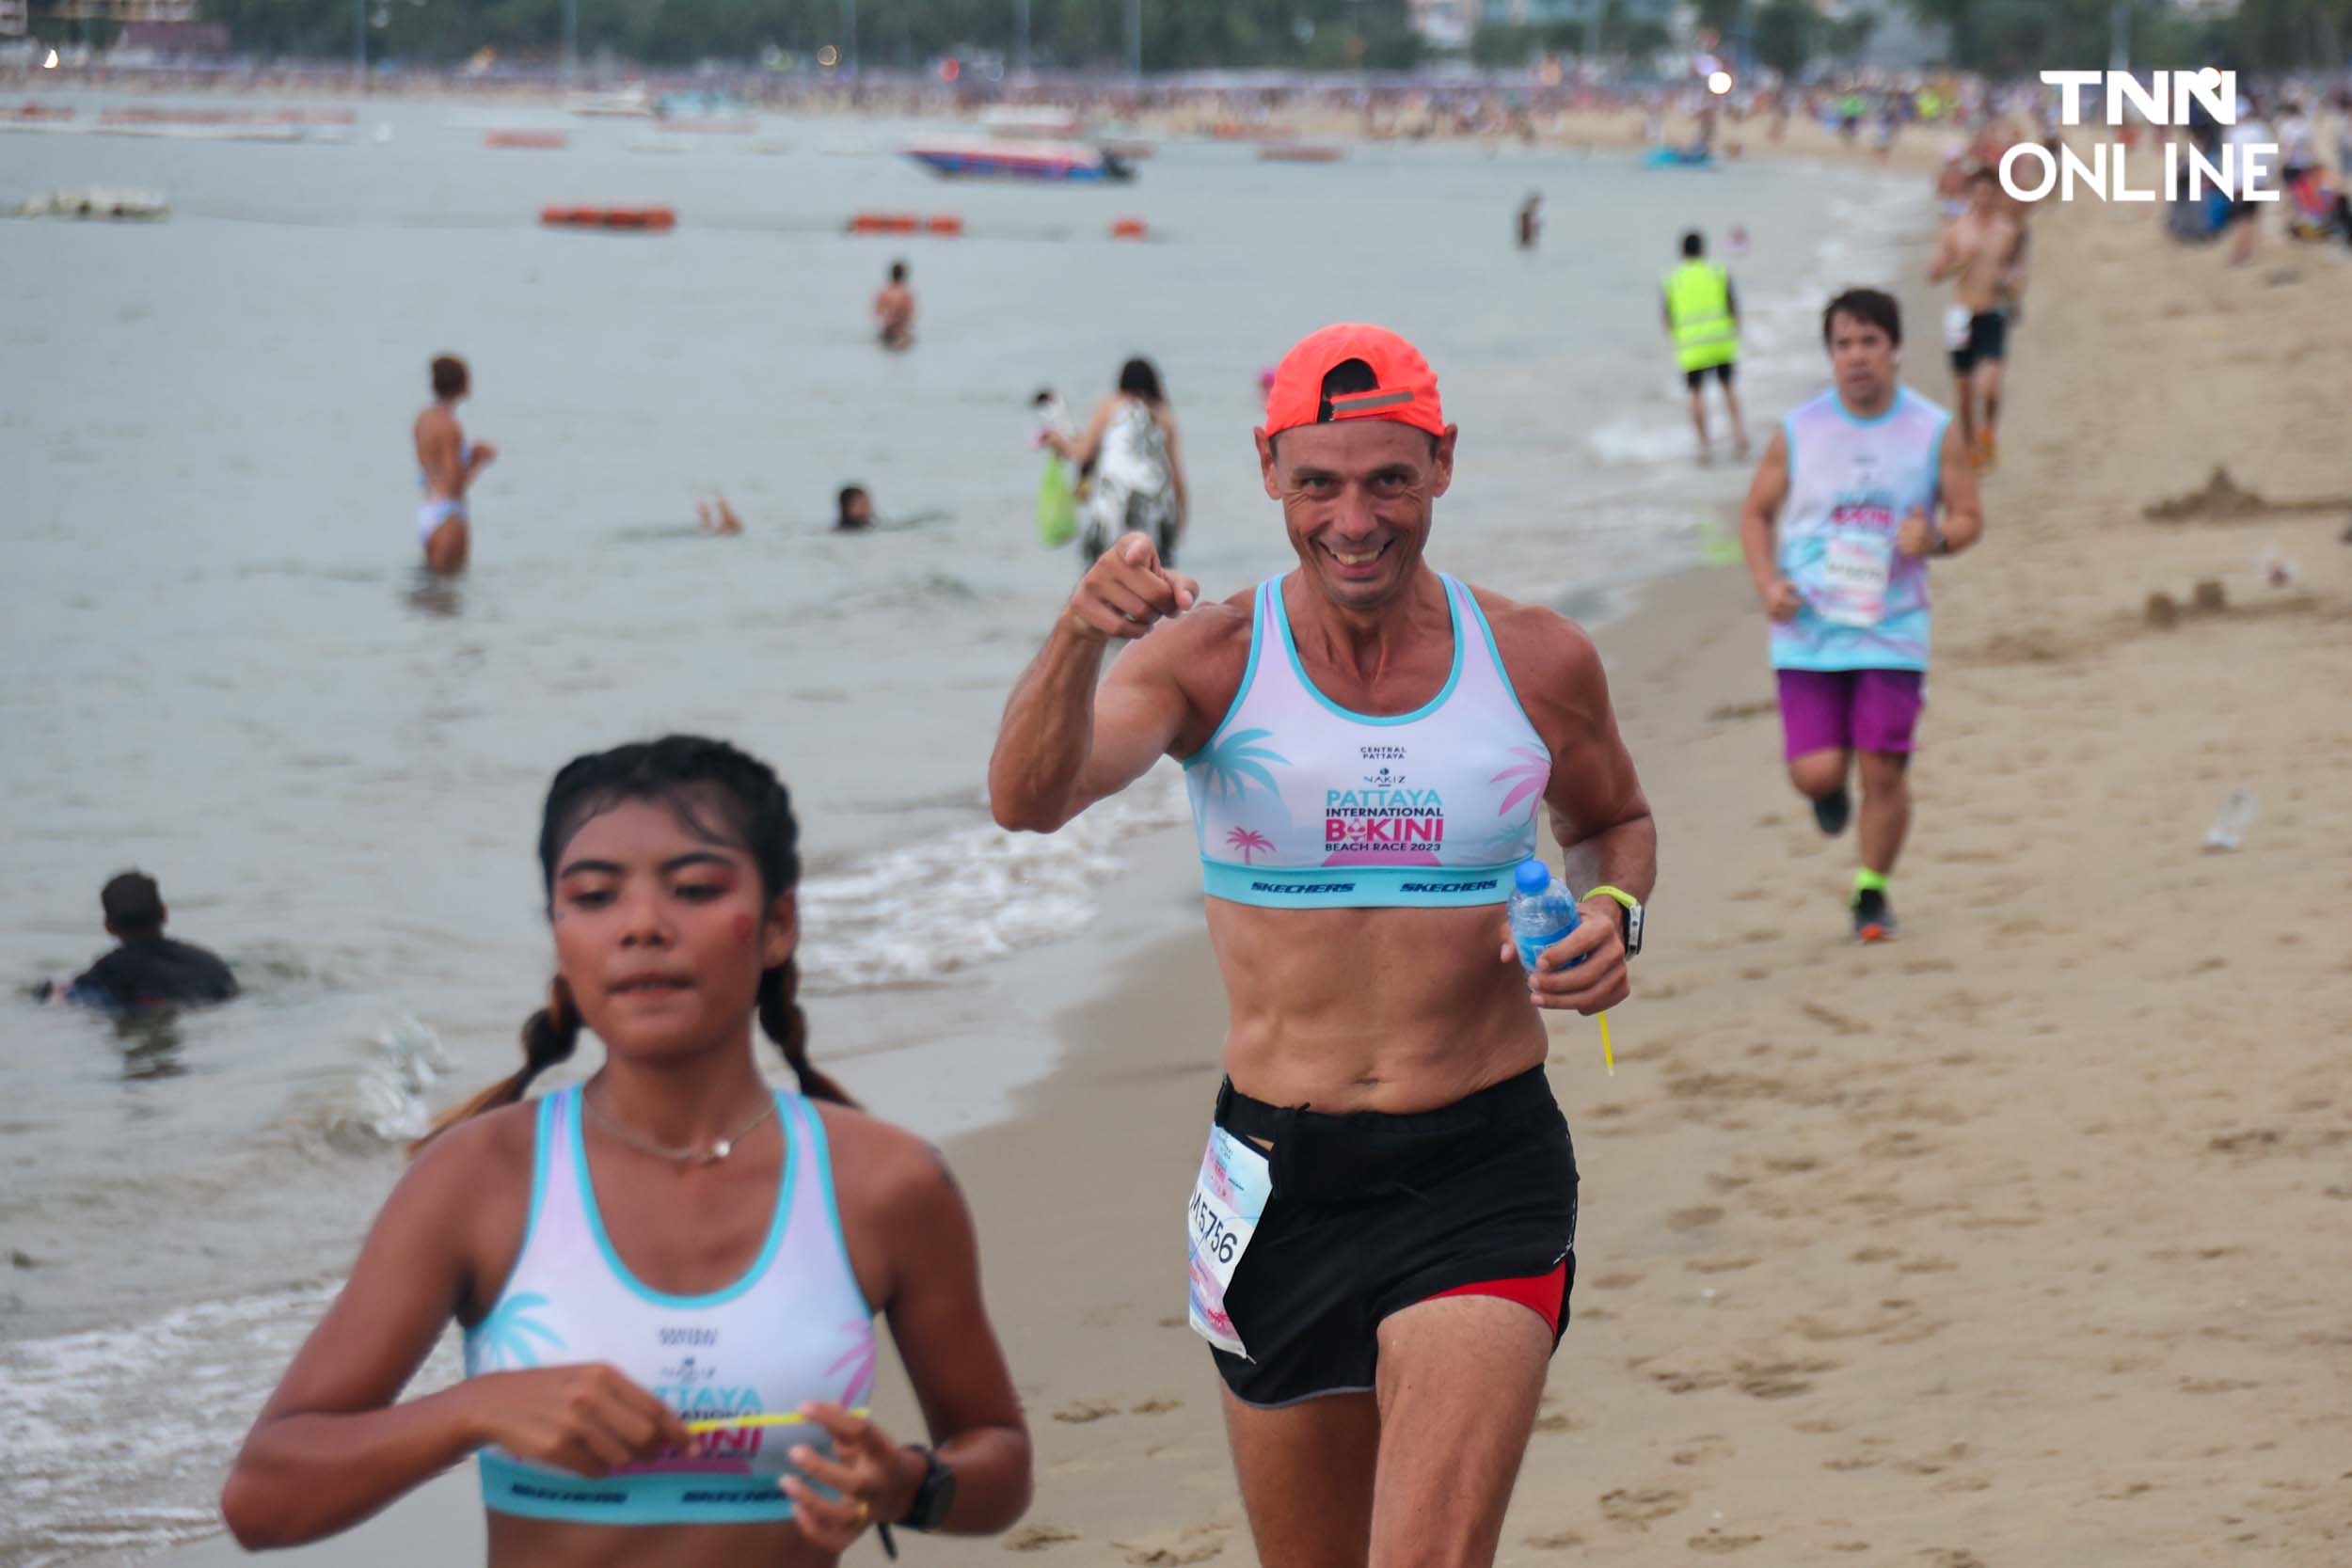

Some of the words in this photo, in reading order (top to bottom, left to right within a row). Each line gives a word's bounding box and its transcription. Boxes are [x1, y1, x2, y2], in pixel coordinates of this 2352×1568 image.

[1326, 789, 1443, 807] PATTAYA
[1326, 807, 1444, 817] INTERNATIONAL
[1325, 843, 1369, 852] BEACH
[1373, 843, 1407, 852] RACE
[1410, 843, 1441, 852] 2023
[1250, 881, 1356, 894] SKECHERS
[1399, 879, 1498, 893] SKECHERS
